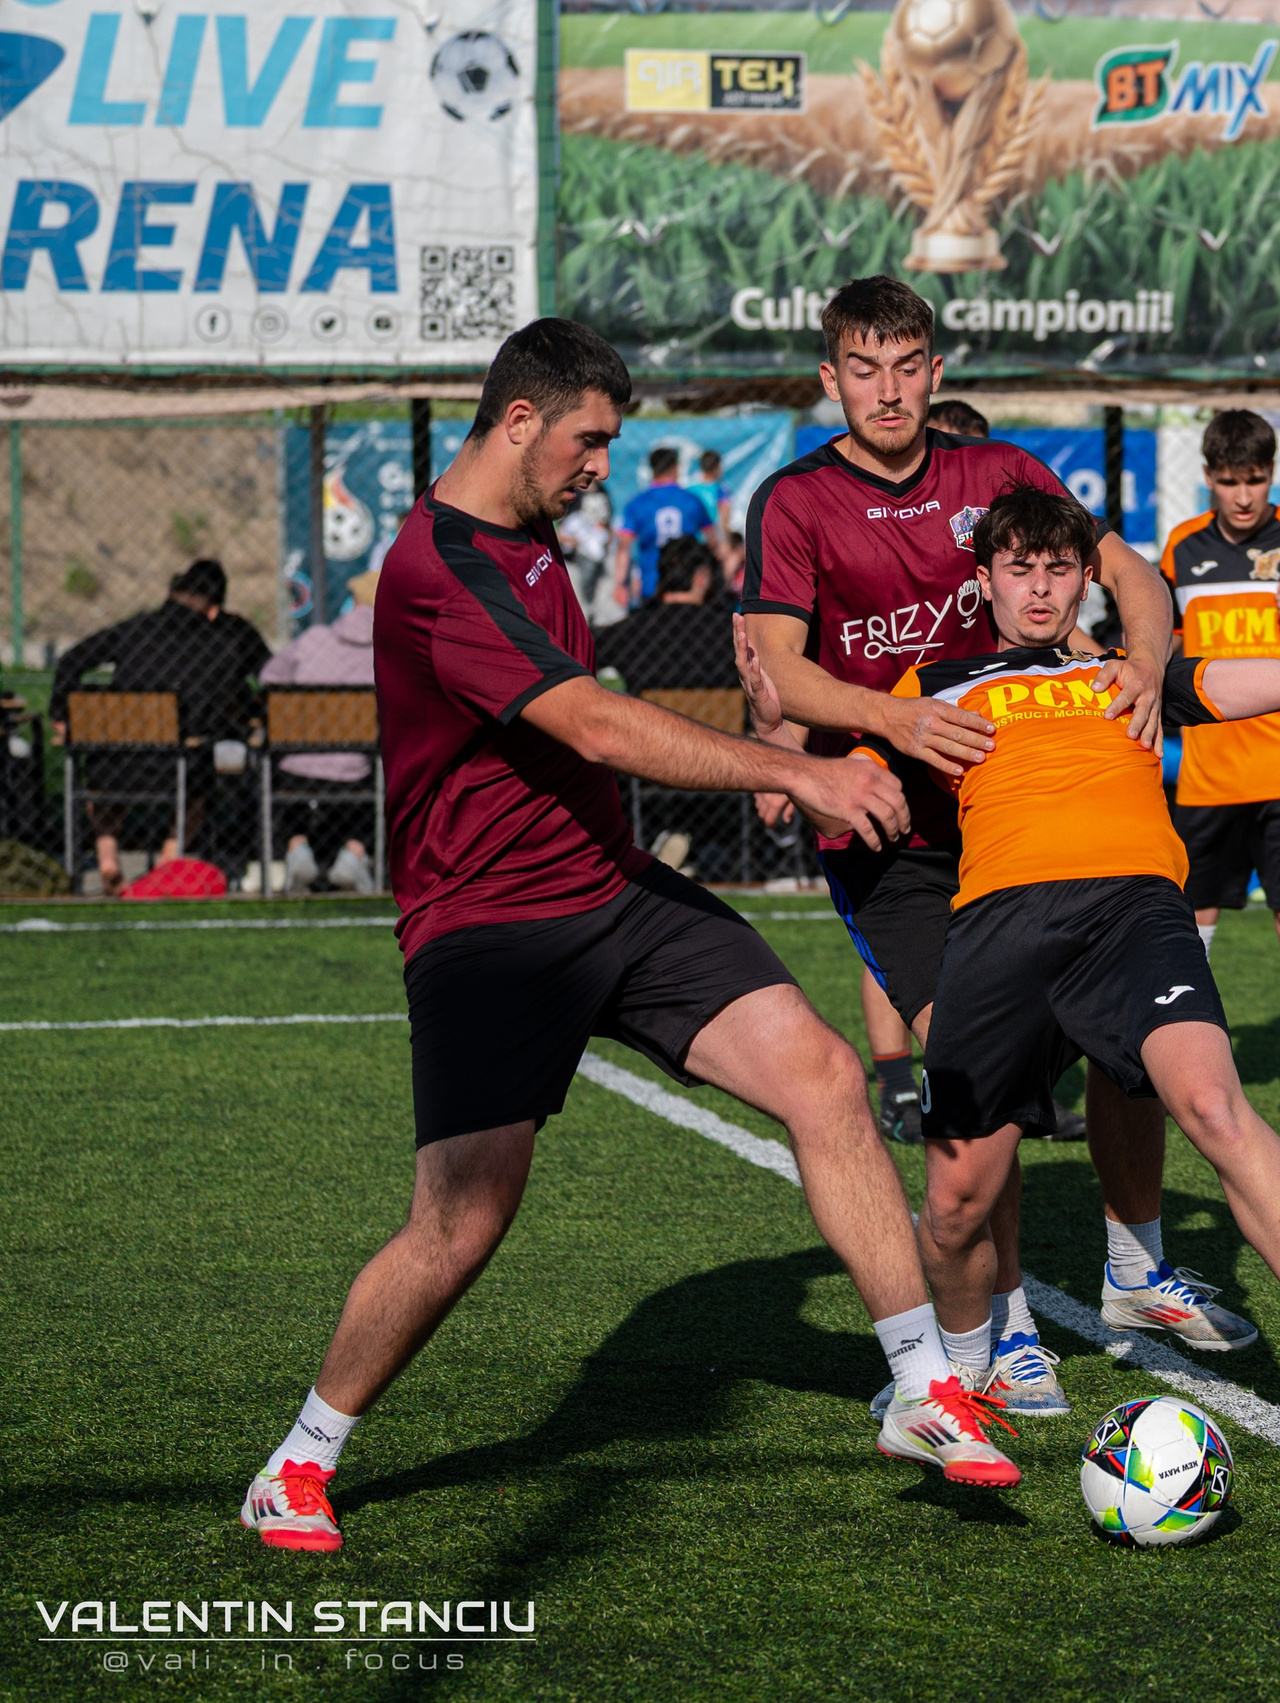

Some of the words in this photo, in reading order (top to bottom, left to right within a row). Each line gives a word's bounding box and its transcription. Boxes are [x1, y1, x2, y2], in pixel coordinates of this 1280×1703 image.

[67, 13, 397, 128] LIVE
[1106, 57, 1166, 112] BT
[1171, 44, 1277, 137] MIX
[0, 179, 401, 293] RENA
[942, 289, 1175, 341] campionii!
[867, 500, 941, 519] GIVOVA
[525, 548, 553, 588] GIVOV
[1197, 608, 1279, 647] PCM
[985, 679, 1112, 719] PCM
[994, 711, 1050, 729] NSTRUCT
[1158, 1466, 1181, 1480] MAYA
[1182, 1460, 1199, 1473] NEW
